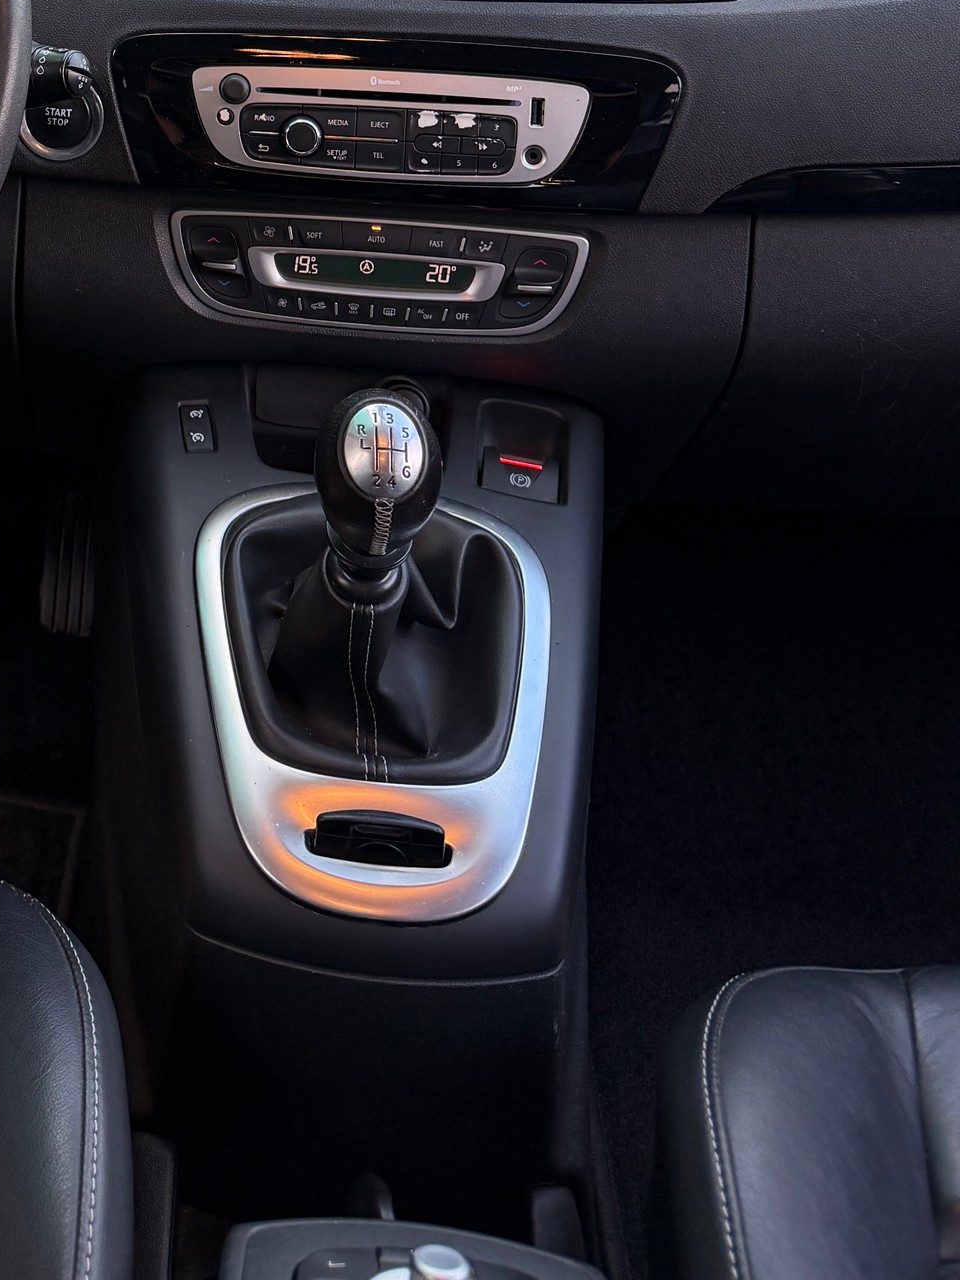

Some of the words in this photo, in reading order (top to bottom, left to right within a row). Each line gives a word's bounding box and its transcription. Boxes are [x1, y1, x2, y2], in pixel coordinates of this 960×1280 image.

[44, 107, 73, 118] START
[47, 117, 69, 126] STOP
[327, 119, 349, 127] MEDIA
[370, 121, 389, 129] EJECT
[306, 231, 323, 239] SOFT
[367, 236, 386, 244] AUTO
[429, 240, 444, 248] FAST
[455, 312, 470, 321] OFF
[372, 412, 378, 424] 1
[386, 413, 394, 424] 3
[357, 424, 366, 435] R
[402, 427, 409, 438] 5
[402, 466, 411, 478] 6
[372, 474, 381, 487] 2
[386, 475, 396, 489] 4
